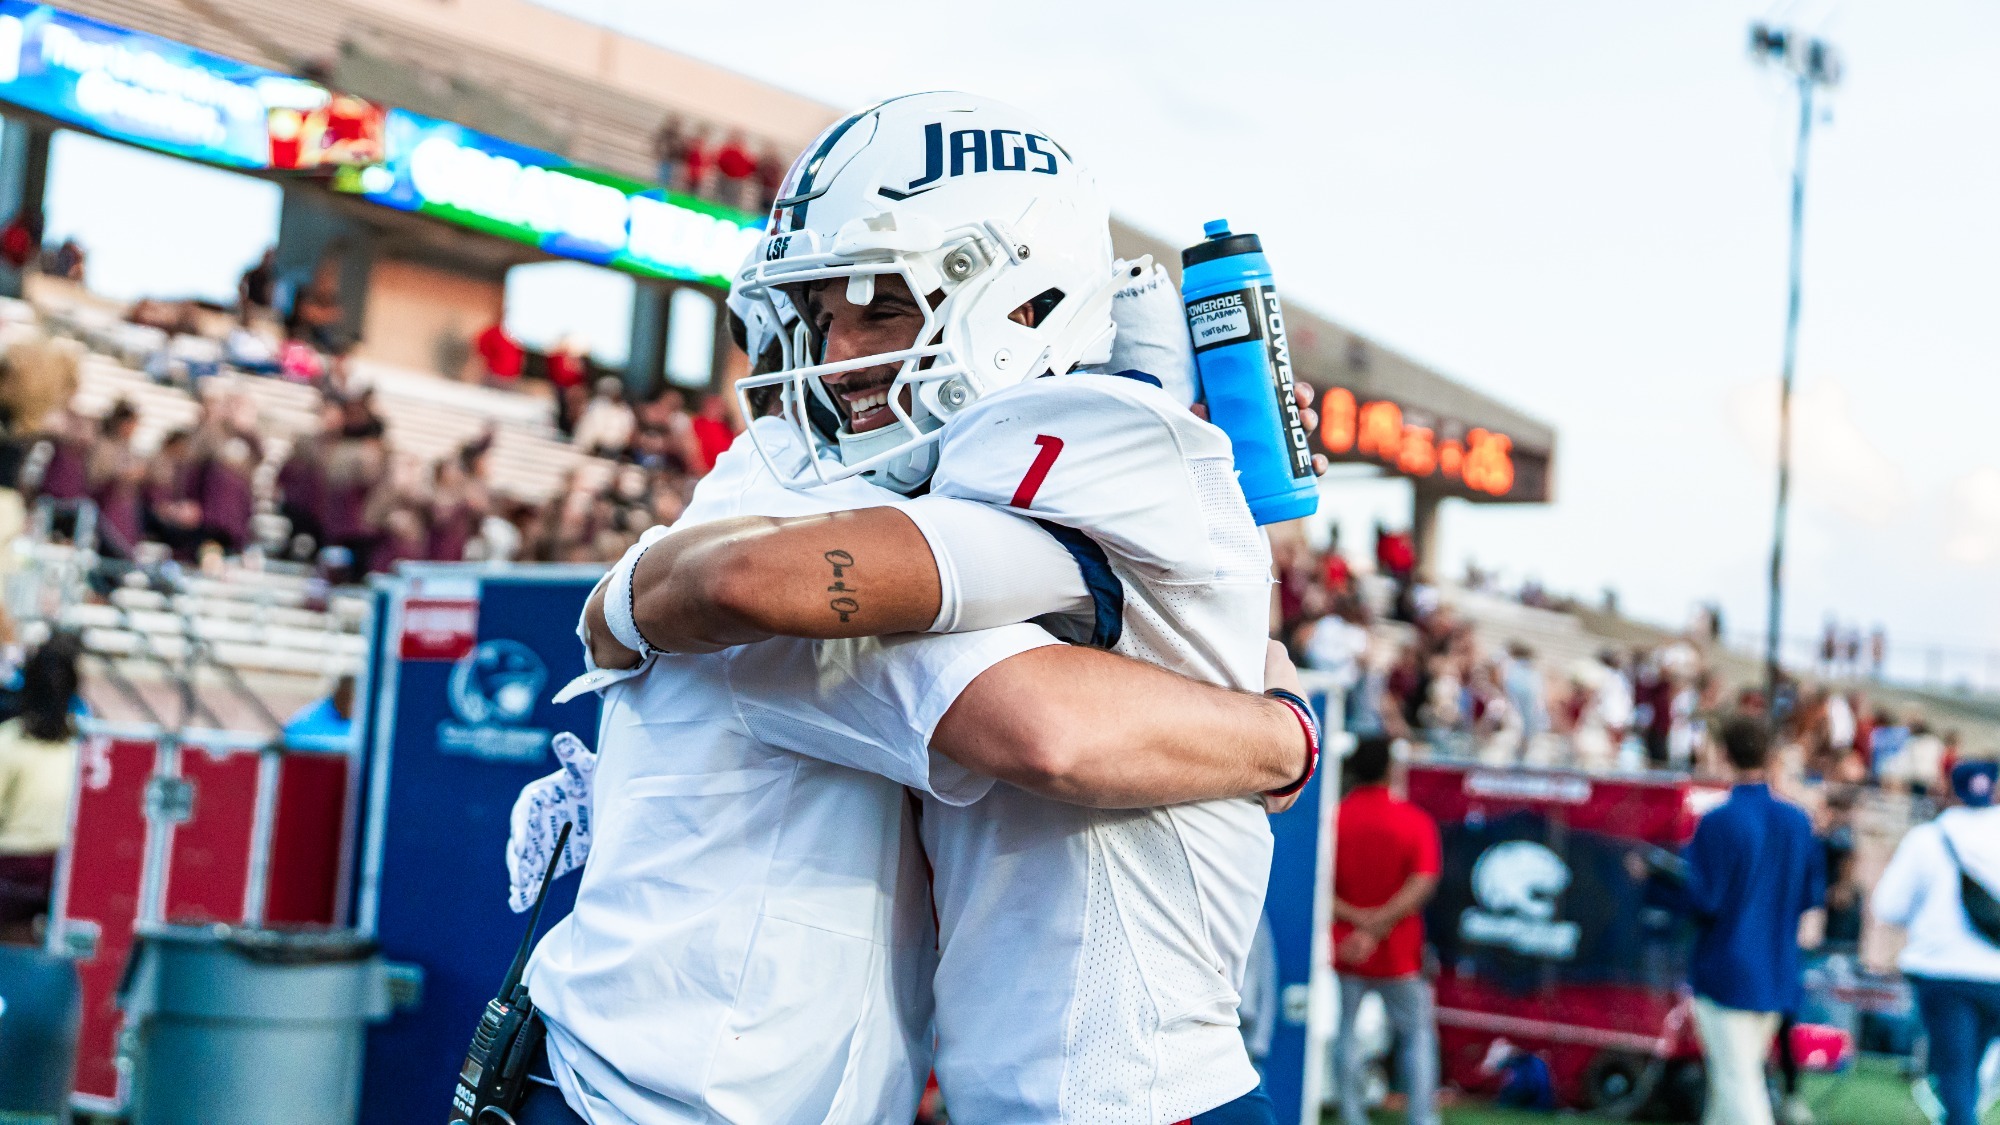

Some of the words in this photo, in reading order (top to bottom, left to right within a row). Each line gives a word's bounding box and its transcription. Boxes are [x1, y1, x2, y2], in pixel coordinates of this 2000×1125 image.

[908, 121, 1058, 190] JAGS
[766, 235, 793, 261] LSF
[1264, 291, 1312, 468] POWERADE
[1009, 433, 1065, 510] 1
